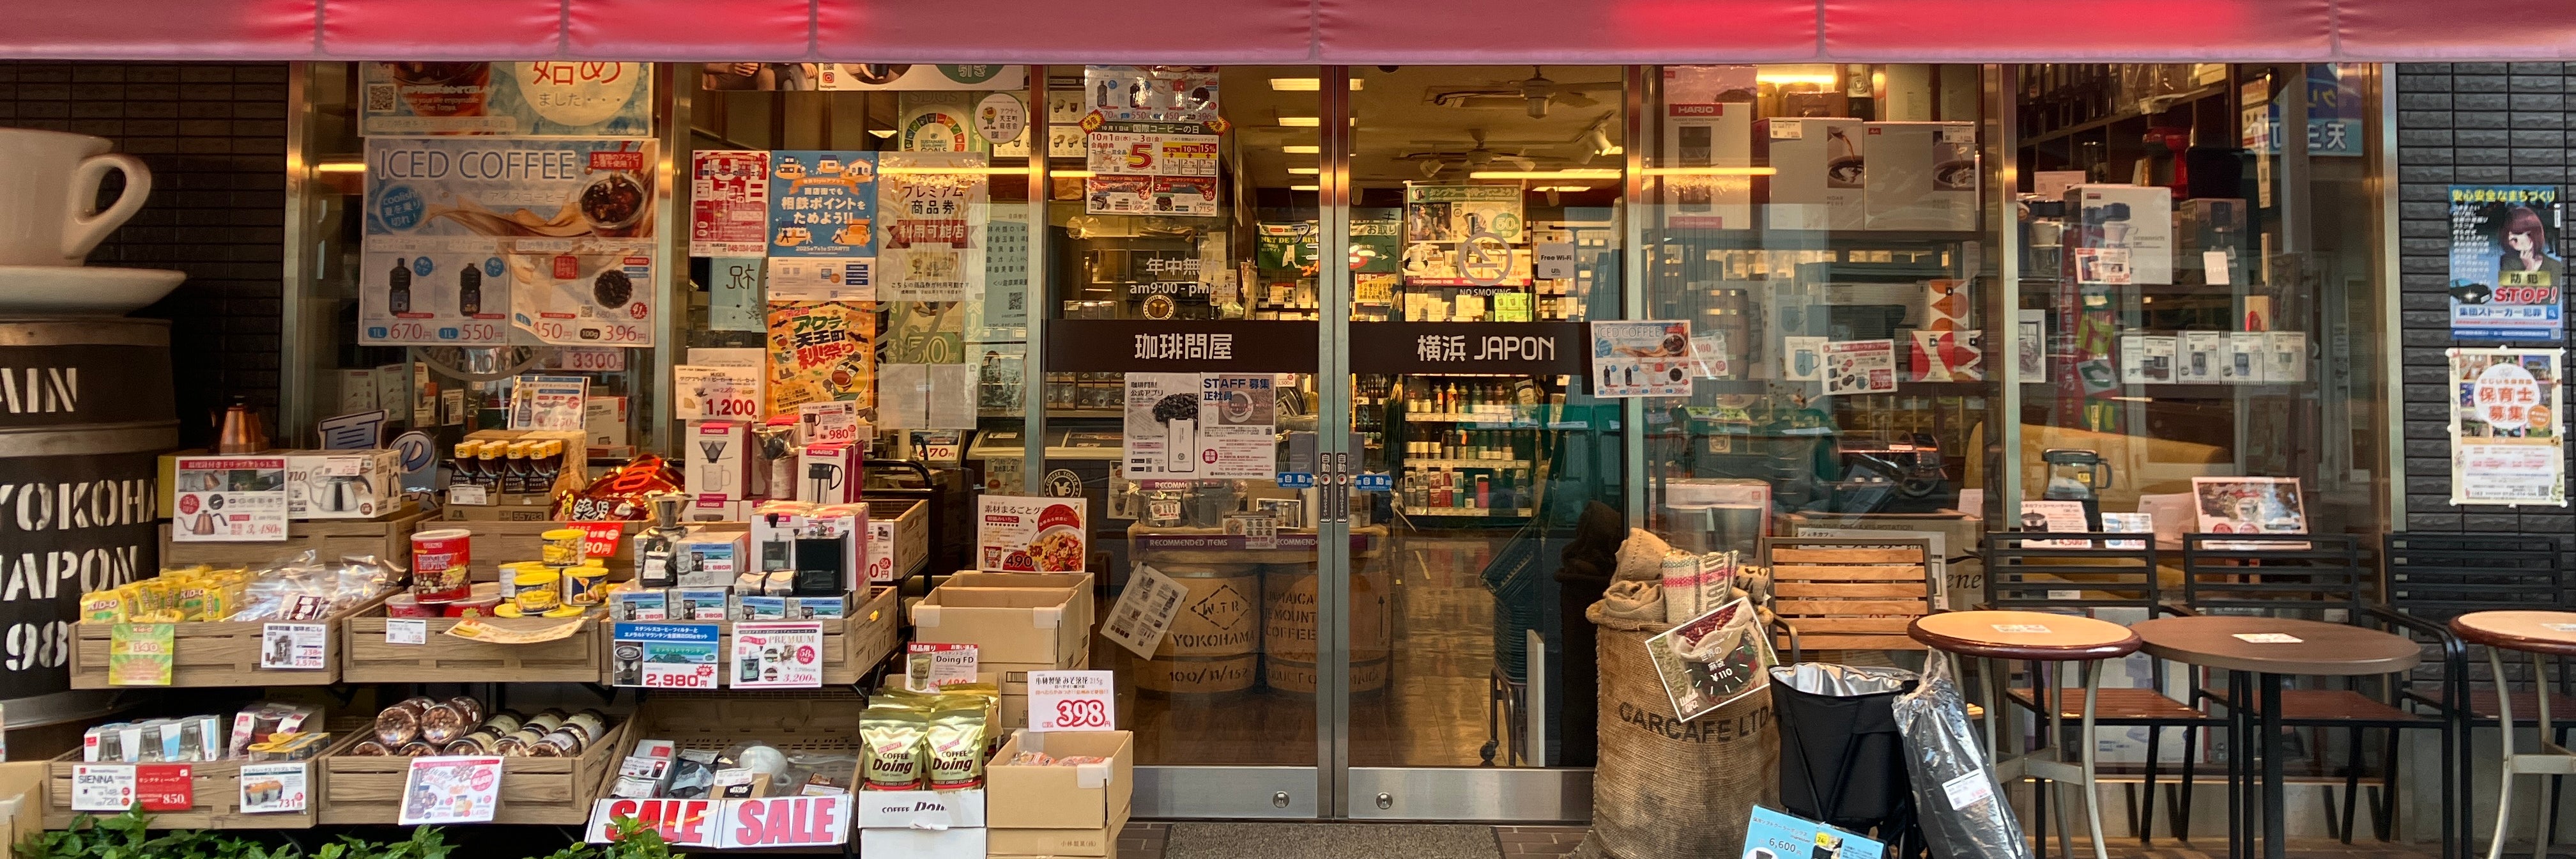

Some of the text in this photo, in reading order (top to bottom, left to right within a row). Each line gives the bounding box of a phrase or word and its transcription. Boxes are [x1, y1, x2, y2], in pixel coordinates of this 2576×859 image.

[1133, 124, 1200, 134] 国際コーヒーの日
[1200, 144, 1216, 152] 15%
[1127, 142, 1153, 170] 5
[381, 150, 574, 180] ICED COFFEE
[490, 192, 568, 203] アイスコーヒー
[804, 187, 844, 196] 商店街でも
[902, 185, 964, 198] プレミアム
[2452, 189, 2556, 203] 安心安全なまちづくり
[781, 197, 866, 210] 相鉄ポイントを
[910, 199, 955, 215] 商品券
[793, 212, 854, 224] ためよう!!
[899, 224, 965, 238] 利用可能店
[1367, 225, 1397, 235] お取り
[2510, 274, 2539, 284] 防犯
[1130, 282, 1178, 294] am9:00
[2494, 286, 2558, 304] STOP!
[2460, 306, 2543, 317] 集団ストーカー犯罪
[372, 323, 432, 339] 1L 670円
[792, 314, 851, 334] アクティ
[443, 323, 503, 340] 1L 550円
[582, 325, 647, 341] 100g 396円
[1597, 327, 1661, 337] ICED COFFEE
[794, 329, 846, 349] 天王町
[1134, 333, 1232, 360] 珈琲問屋
[1417, 334, 1554, 362] 横浜 JAPON
[796, 341, 855, 370] 秋祭り
[1203, 378, 1270, 389] STAFF 募集
[1203, 391, 1233, 401] 正社員
[2480, 387, 2534, 403] 保育士
[2488, 405, 2524, 421] 募集
[1321, 454, 1330, 473] 自動
[1338, 454, 1347, 473] 自動
[1285, 474, 1307, 483] 自動
[1363, 477, 1384, 485] 自動
[513, 512, 543, 521] 55783
[1150, 539, 1205, 547] RECOMMENDED
[1005, 554, 1033, 568] 490
[0, 545, 138, 601] APON
[87, 600, 118, 611] KID-O
[1266, 592, 1315, 605] JAMAICA
[768, 635, 815, 644] PREMIUM
[1172, 631, 1255, 647] YOKOHAMA
[1266, 627, 1317, 640] COFFEE
[936, 656, 961, 665] Doing
[1700, 646, 1722, 662] 世界の
[1708, 659, 1725, 670] 麻袋
[1035, 677, 1062, 685] 小林製菓
[1710, 668, 1733, 682] ¥110
[1618, 702, 1770, 744] CARCAFE LTD
[882, 752, 909, 760] COFFEE
[873, 759, 914, 774] Doing
[932, 757, 972, 772] Doing
[78, 775, 114, 784] SIENNA
[604, 800, 708, 843] SALE
[736, 798, 836, 846] SALE
